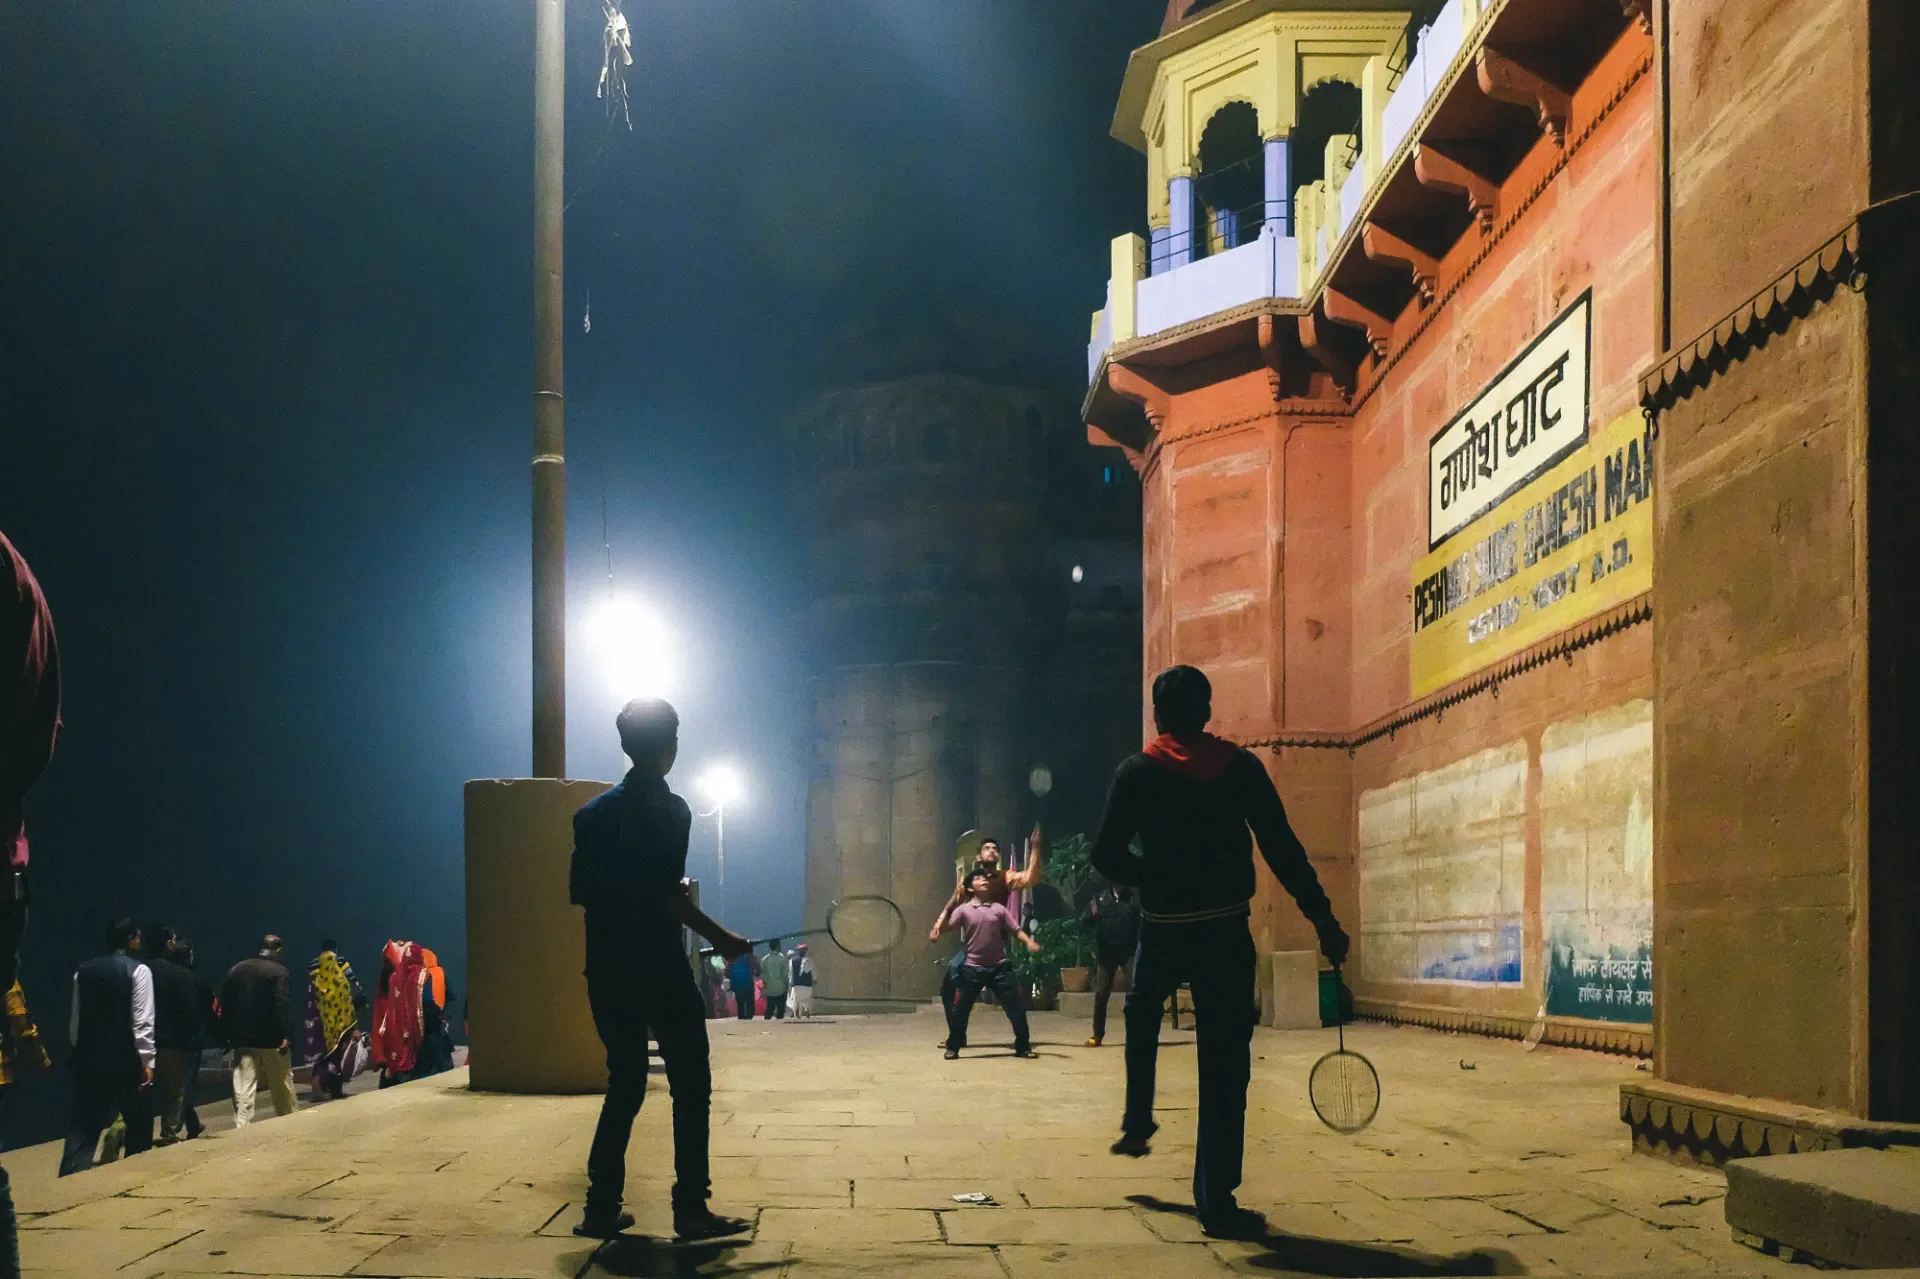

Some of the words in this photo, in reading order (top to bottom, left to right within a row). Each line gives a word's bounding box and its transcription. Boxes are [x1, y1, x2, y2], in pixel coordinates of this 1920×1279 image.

[1440, 410, 1502, 511] गणेश
[1506, 349, 1569, 457] घाट
[1523, 464, 1597, 569] GANESH
